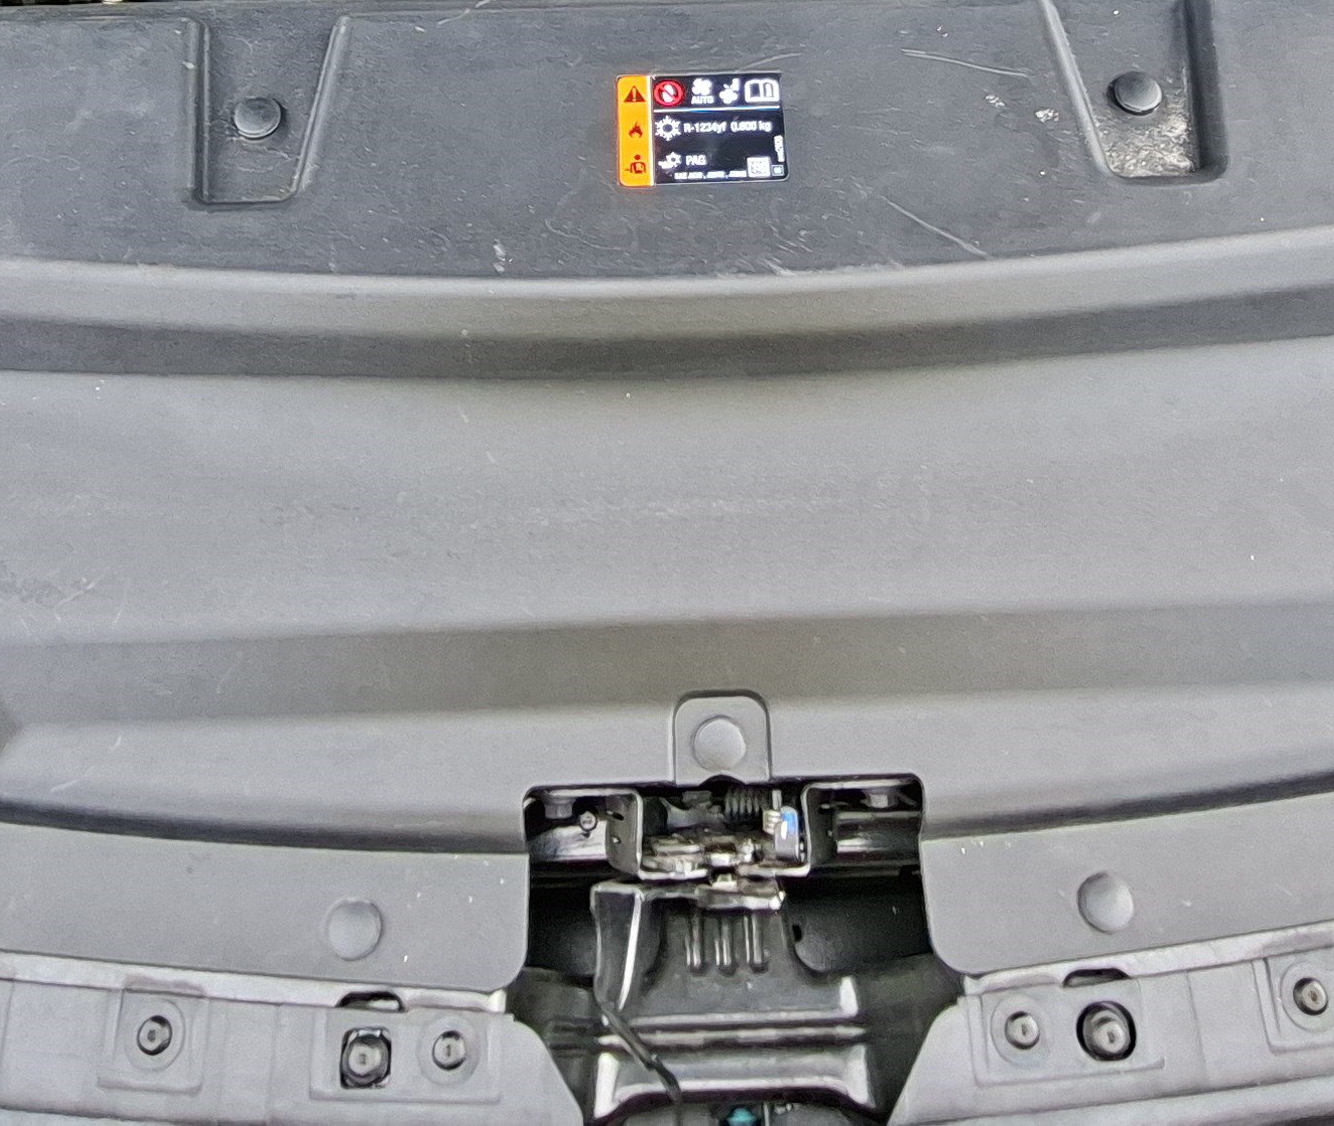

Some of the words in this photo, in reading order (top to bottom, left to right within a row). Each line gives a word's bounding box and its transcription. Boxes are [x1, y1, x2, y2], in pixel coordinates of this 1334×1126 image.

[691, 95, 715, 105] AUTO
[683, 121, 727, 134] R-1234yf
[758, 120, 772, 132] kg
[685, 154, 708, 166] PAG
